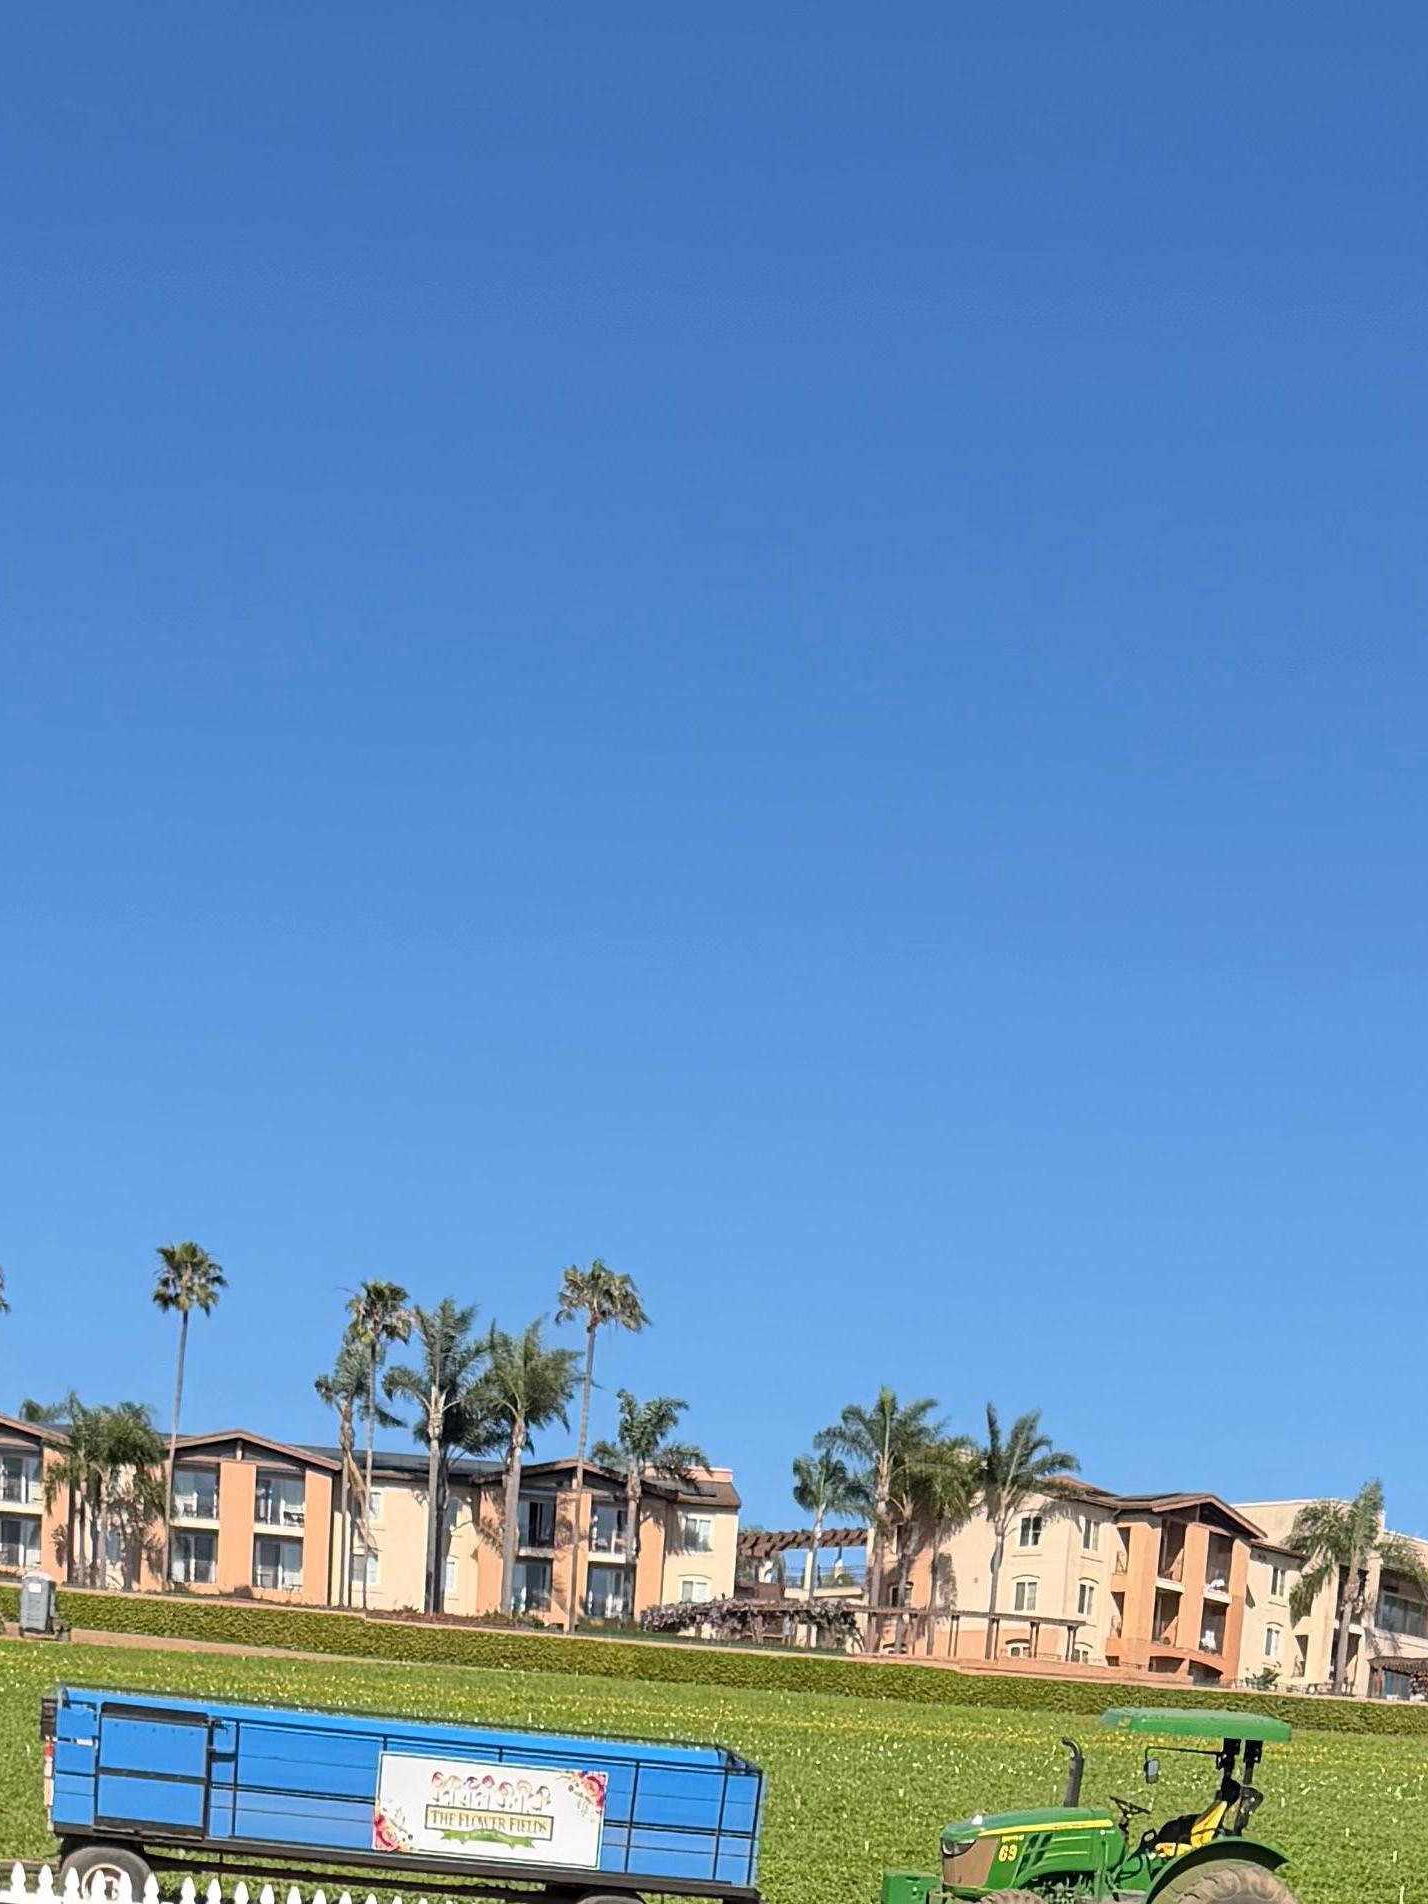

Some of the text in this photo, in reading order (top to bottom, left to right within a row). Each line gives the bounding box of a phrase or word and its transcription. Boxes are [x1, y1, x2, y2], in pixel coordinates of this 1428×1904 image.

[432, 1810, 548, 1834] THE FLOWER FIELDS
